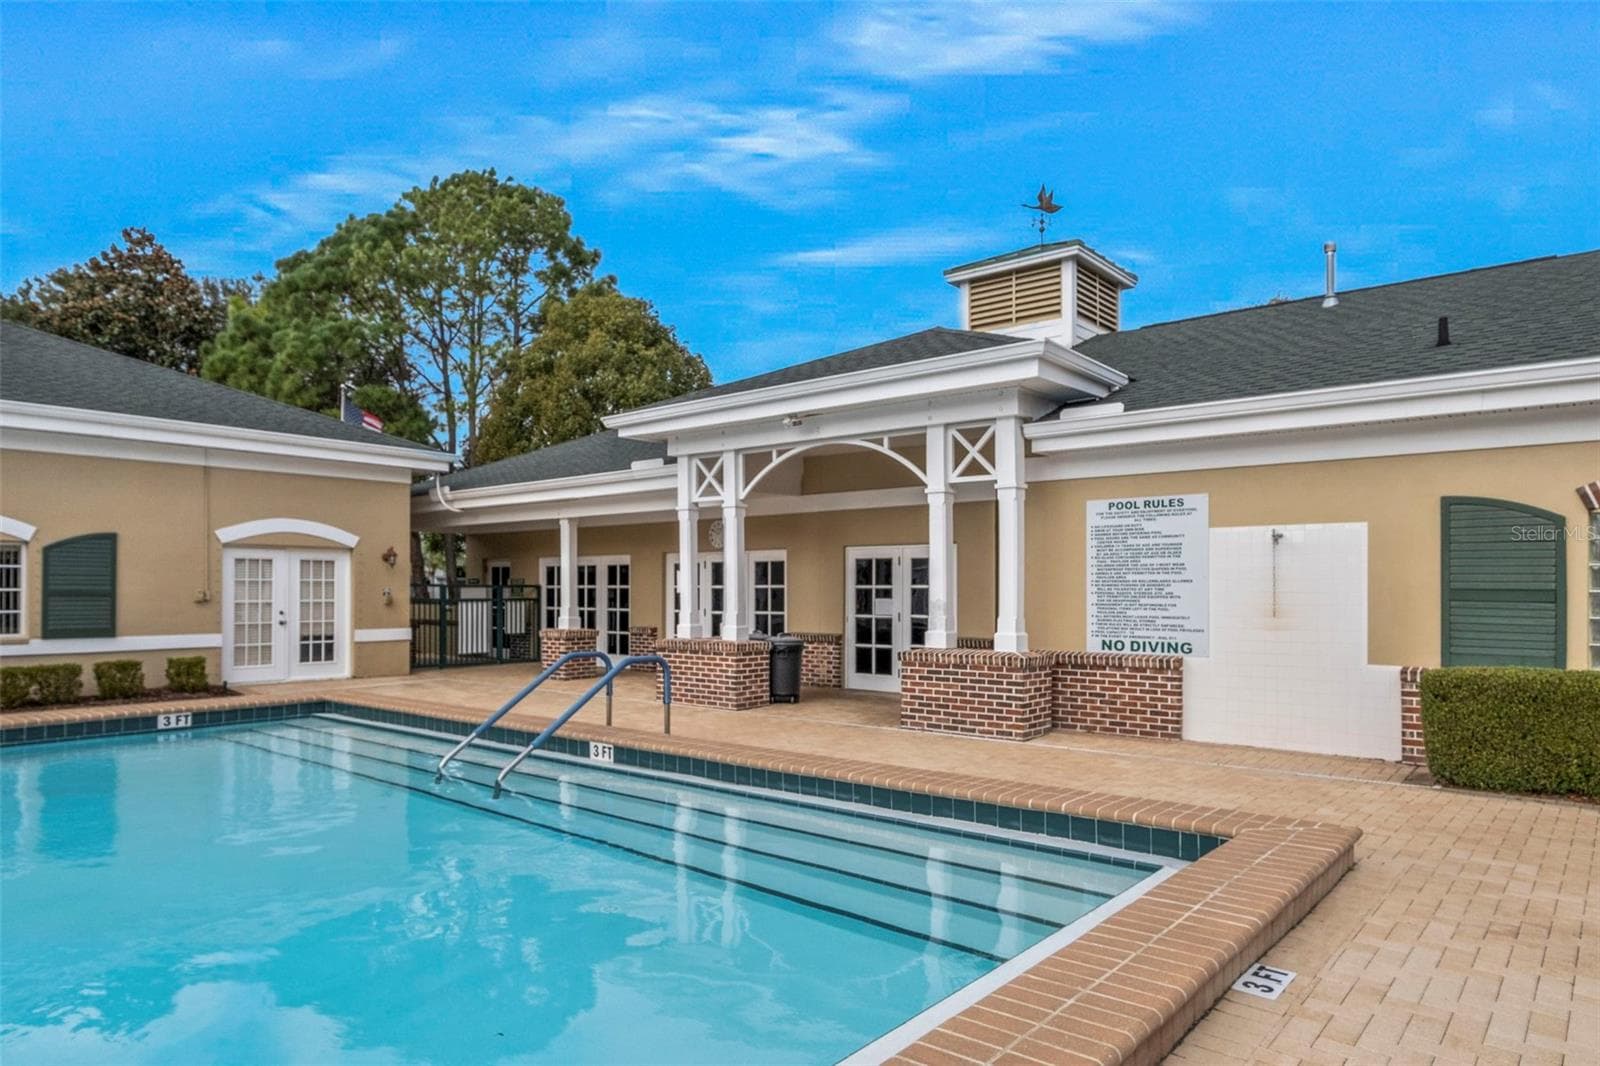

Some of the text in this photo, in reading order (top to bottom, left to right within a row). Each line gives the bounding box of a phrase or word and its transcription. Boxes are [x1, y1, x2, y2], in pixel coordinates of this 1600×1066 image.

[1108, 498, 1185, 511] POOL RULES
[1101, 639, 1193, 654] NO DIVING
[163, 714, 190, 727] 3 FT
[593, 744, 613, 760] 3 FT
[1242, 965, 1289, 993] 3 FT
